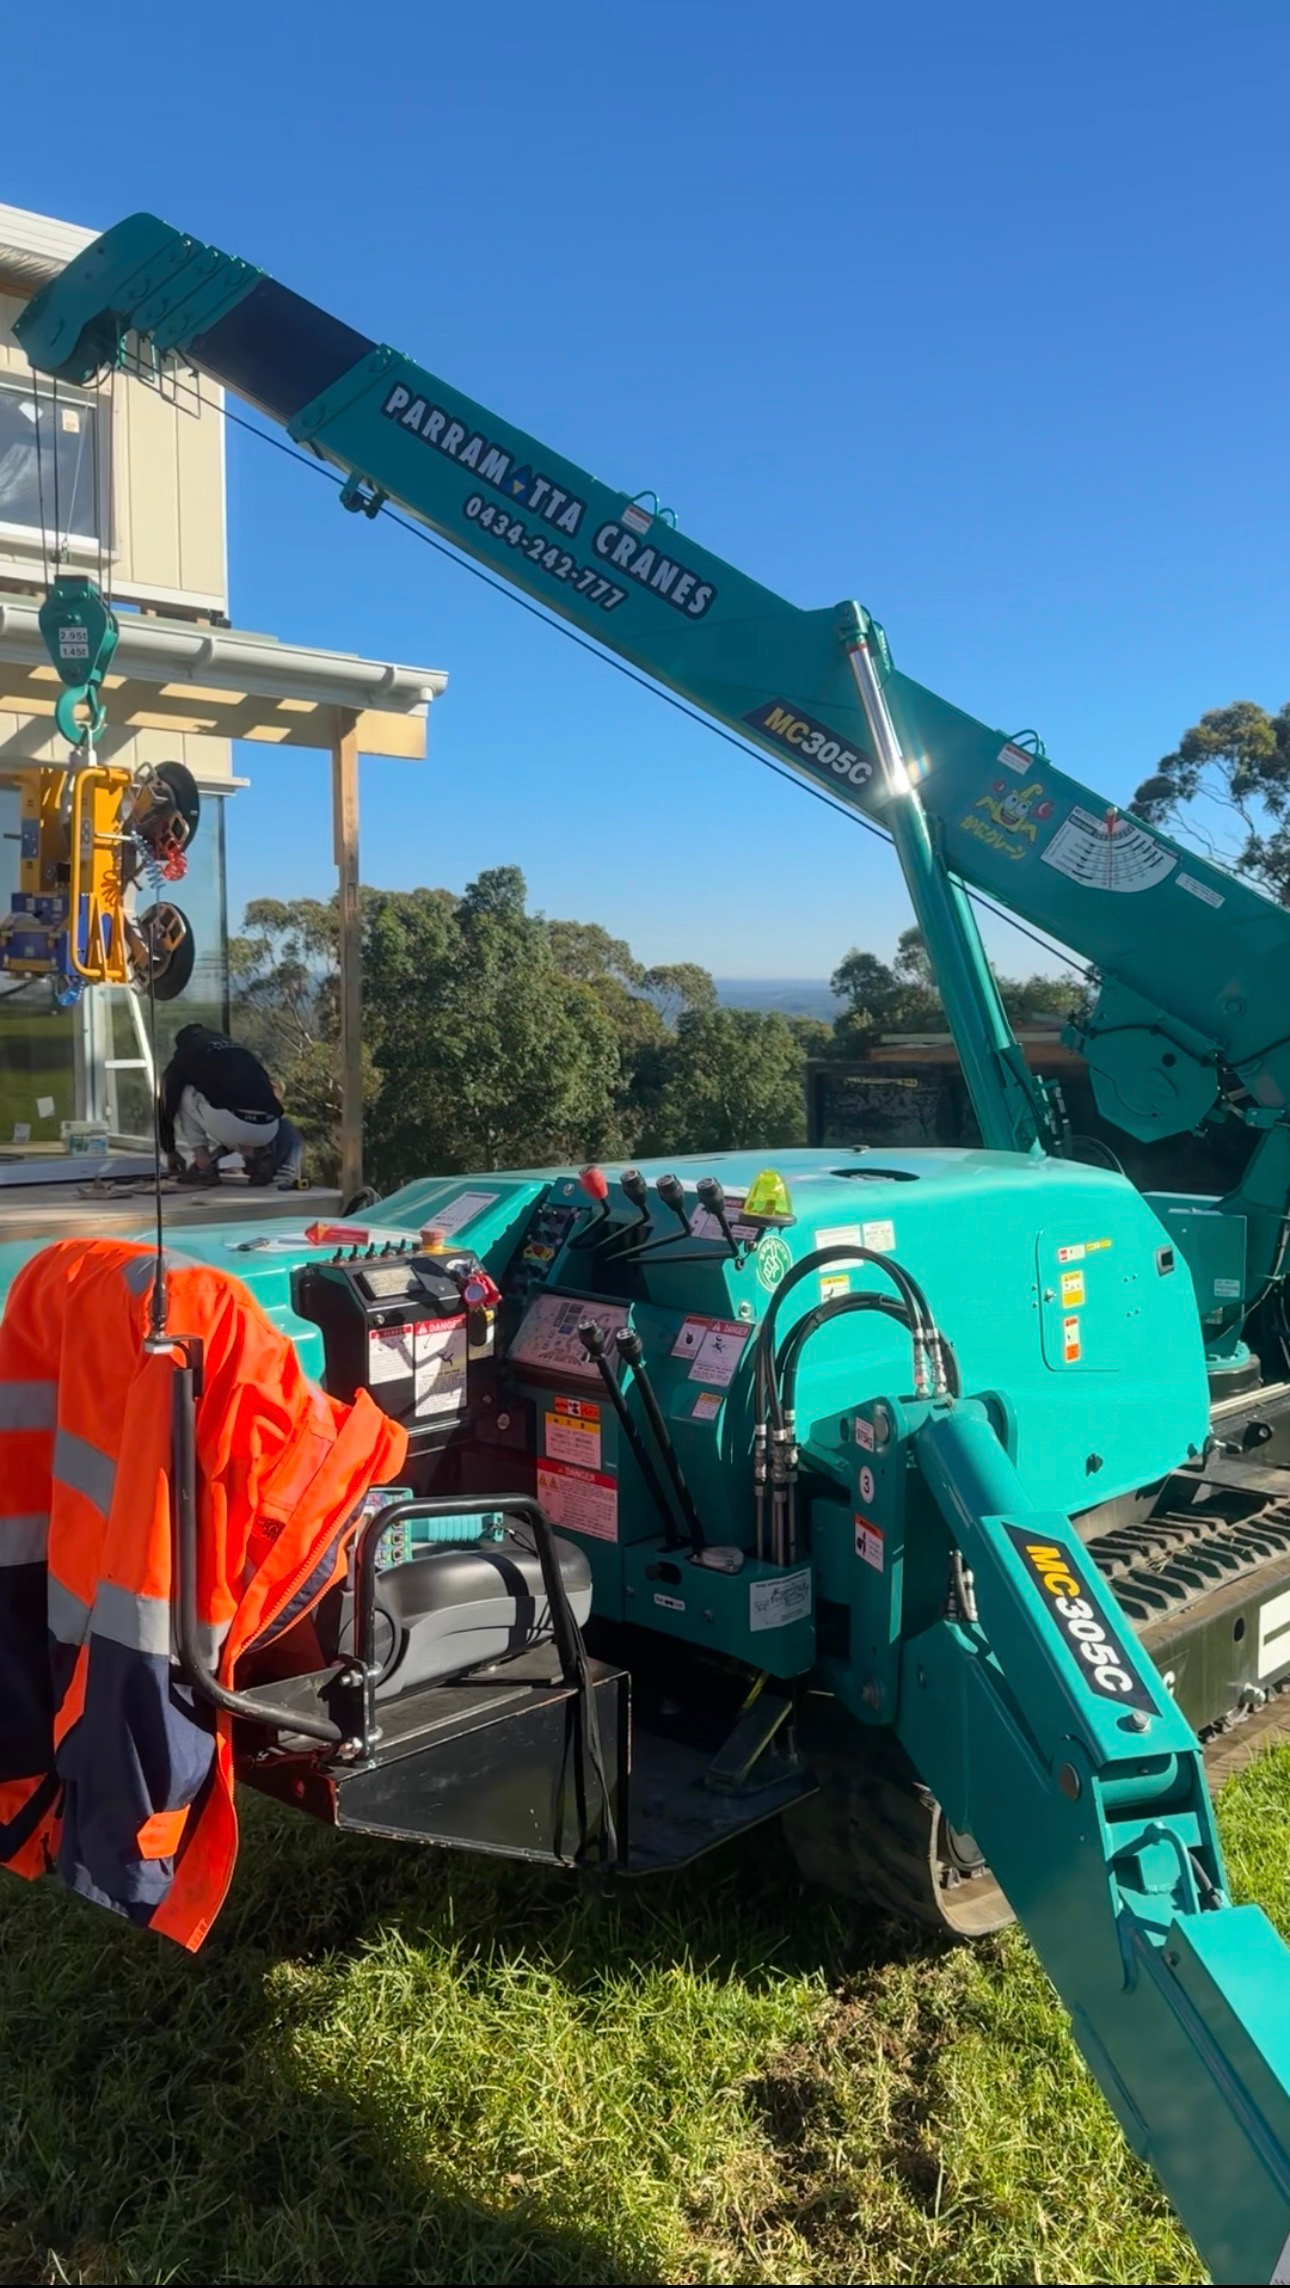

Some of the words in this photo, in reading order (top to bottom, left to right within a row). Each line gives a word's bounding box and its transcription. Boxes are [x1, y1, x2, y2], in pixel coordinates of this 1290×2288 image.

[466, 496, 626, 609] 0434-242-777
[595, 523, 714, 616] CRANES
[59, 631, 87, 640] 2.95t
[62, 647, 86, 656] 1.45t
[763, 706, 873, 785] MC305C
[564, 1466, 596, 1482] DANGER
[863, 1474, 870, 1494] 3
[1025, 1543, 1134, 1694] MC305C
